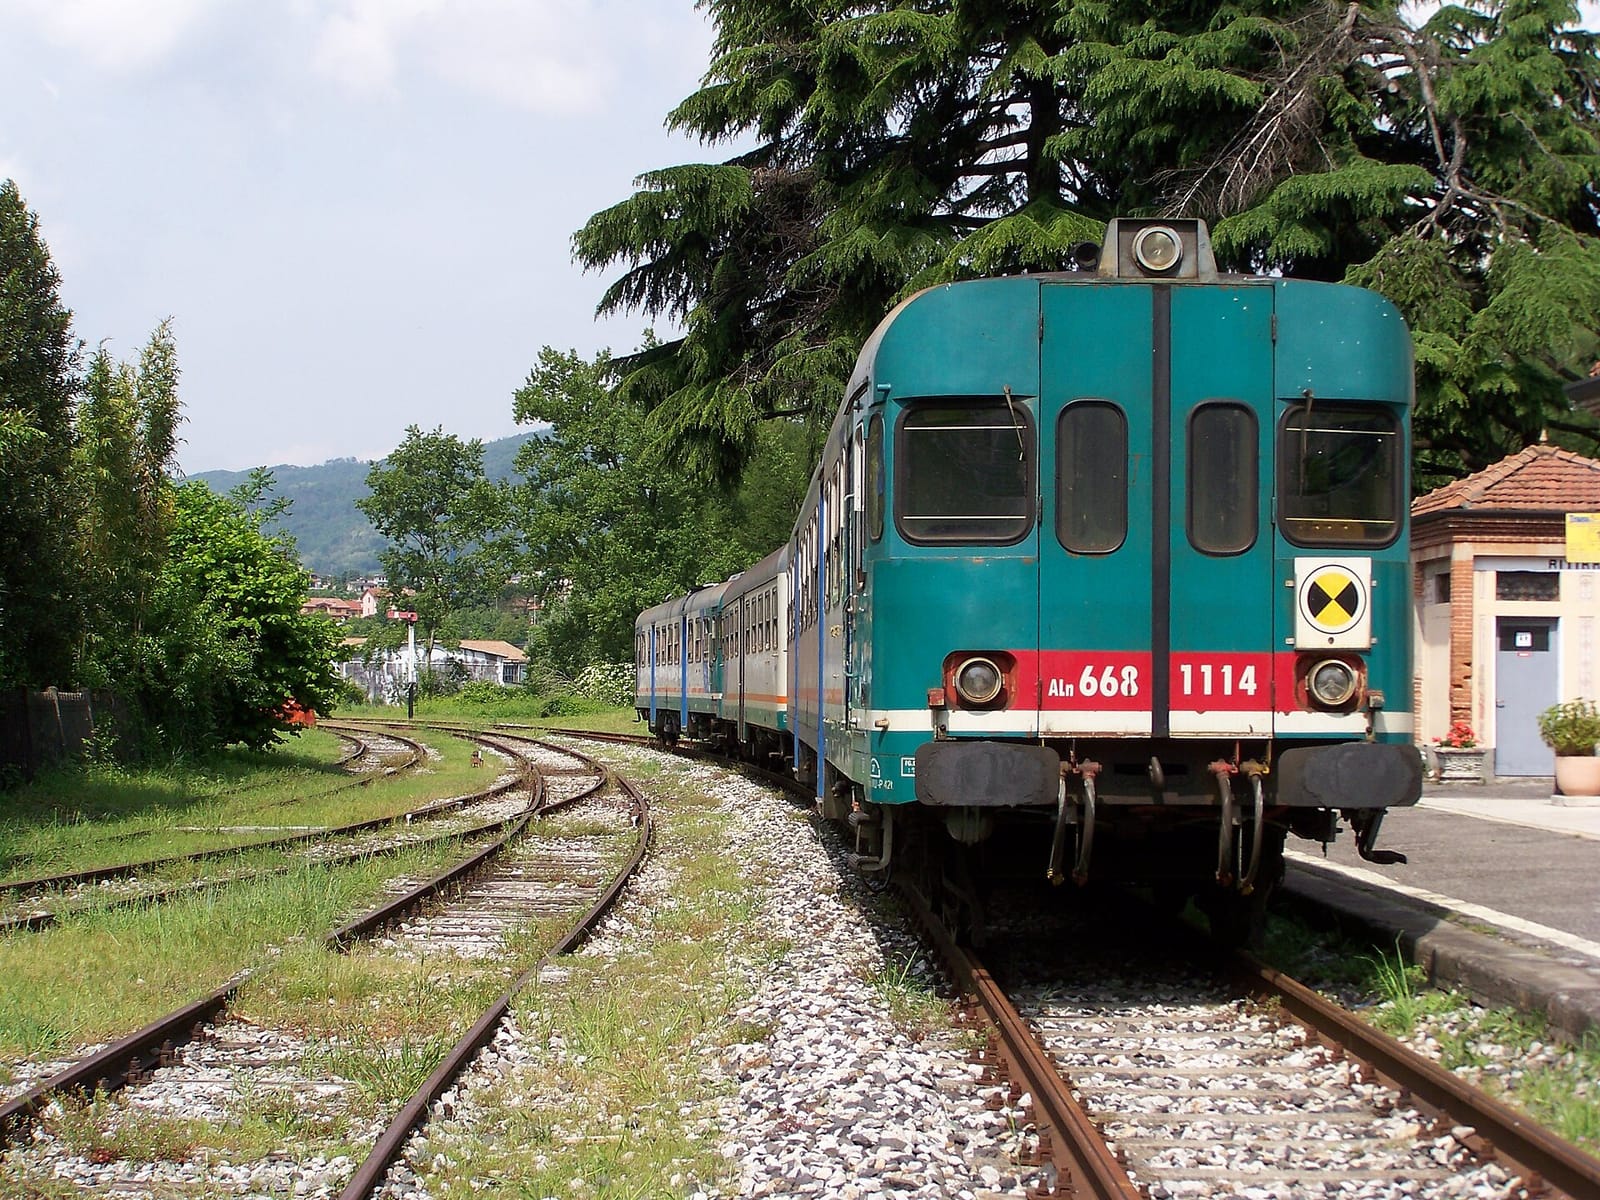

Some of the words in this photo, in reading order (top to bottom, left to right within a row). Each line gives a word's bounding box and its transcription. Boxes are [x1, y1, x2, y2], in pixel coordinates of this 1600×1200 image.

[1048, 679, 1074, 697] ALn
[1079, 665, 1139, 697] 668
[1180, 664, 1257, 696] 1114
